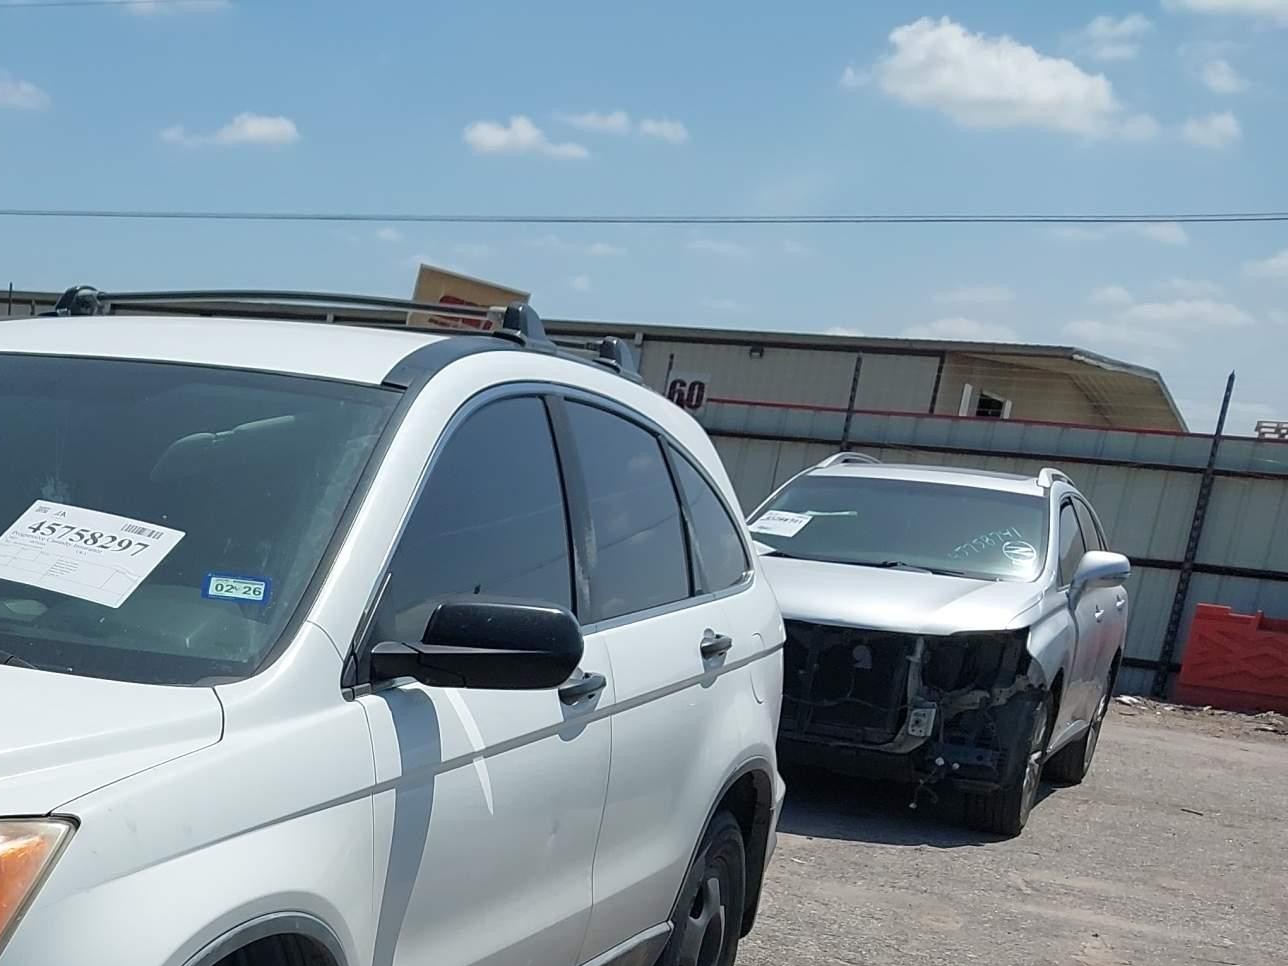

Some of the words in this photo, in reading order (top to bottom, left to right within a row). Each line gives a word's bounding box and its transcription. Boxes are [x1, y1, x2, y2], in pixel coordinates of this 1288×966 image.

[668, 378, 705, 410] 60
[27, 520, 150, 557] 45758297
[214, 583, 234, 594] 02
[242, 585, 262, 597] 26
